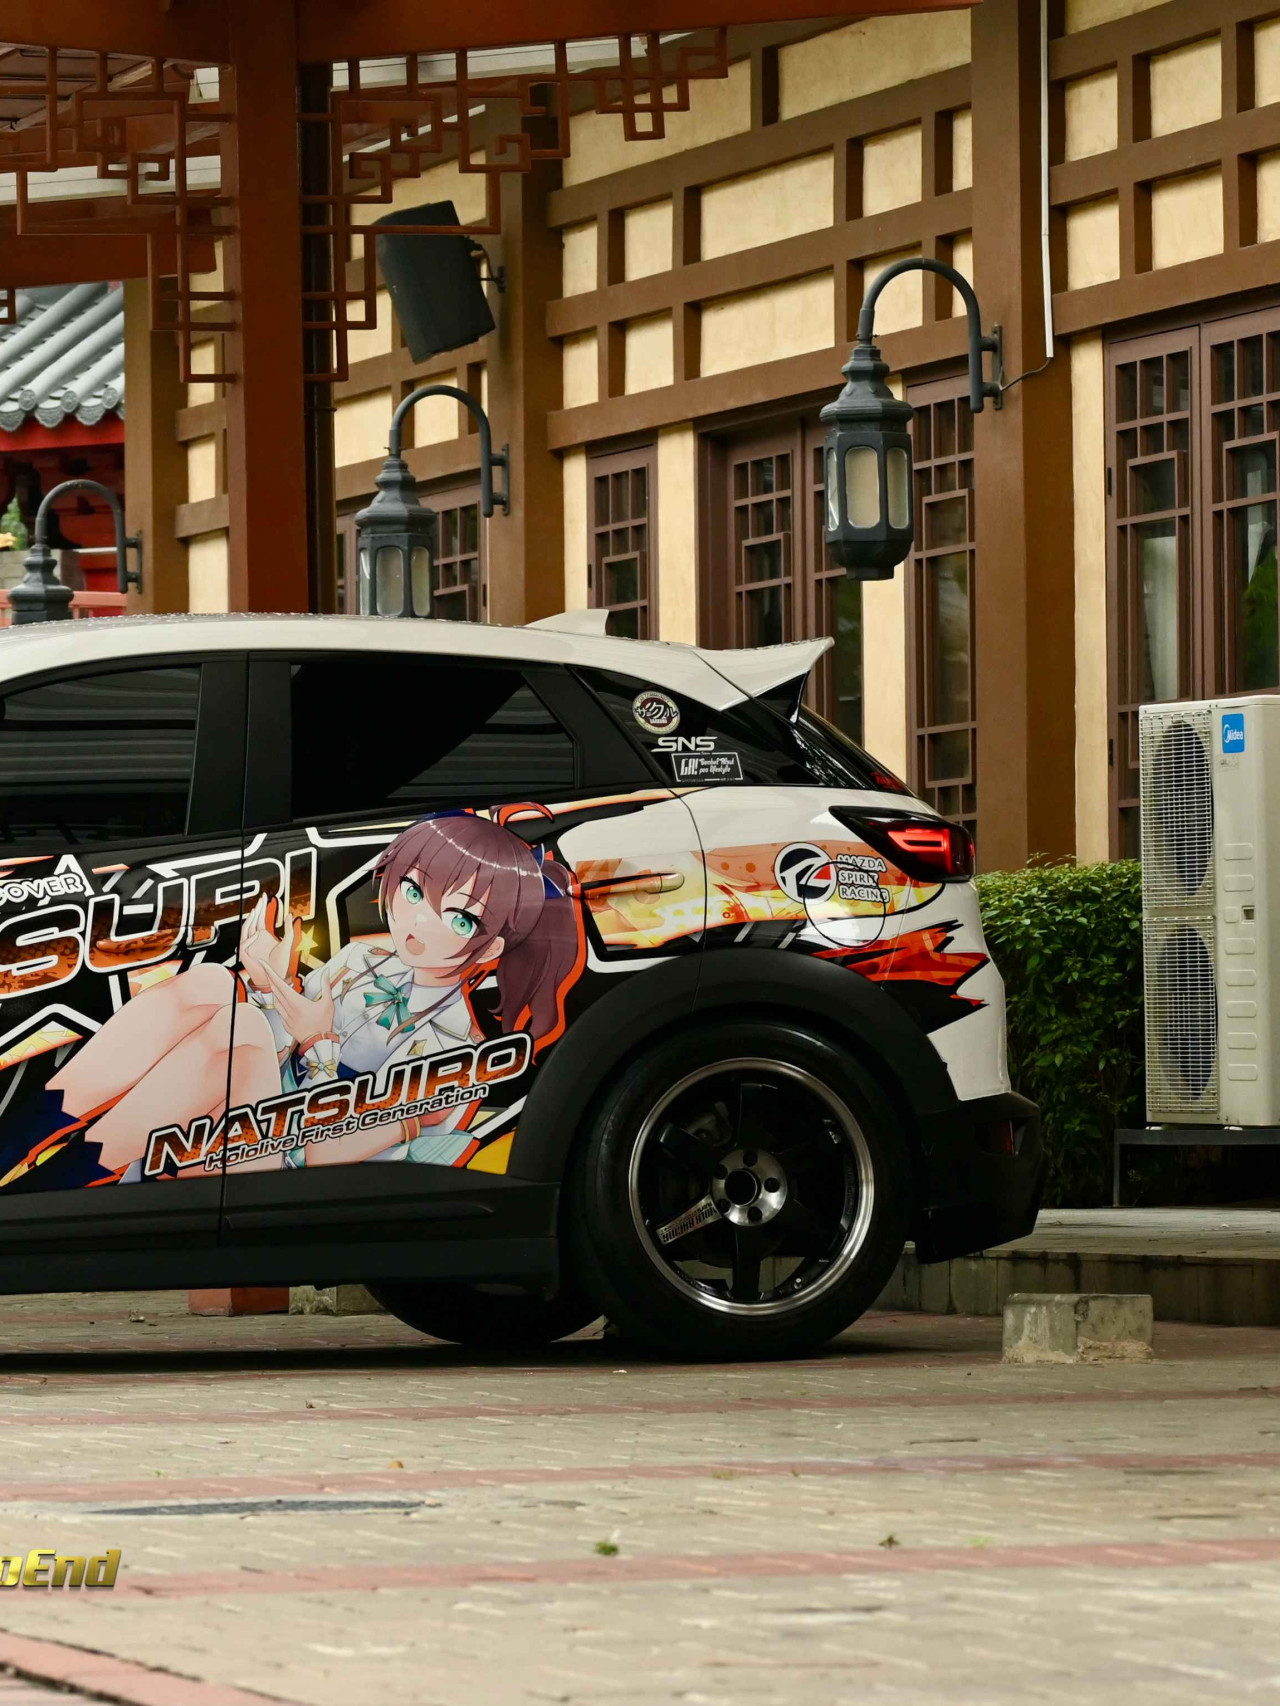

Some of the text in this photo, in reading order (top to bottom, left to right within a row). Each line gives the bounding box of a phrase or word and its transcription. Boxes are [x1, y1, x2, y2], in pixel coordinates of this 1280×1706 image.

[651, 736, 718, 752] SNS
[838, 855, 886, 871] MAZDA
[839, 871, 878, 885] SPIRIT
[840, 886, 889, 902] RACING
[146, 1034, 531, 1175] NATSUIRO
[206, 1085, 489, 1171] Hololive First Generation
